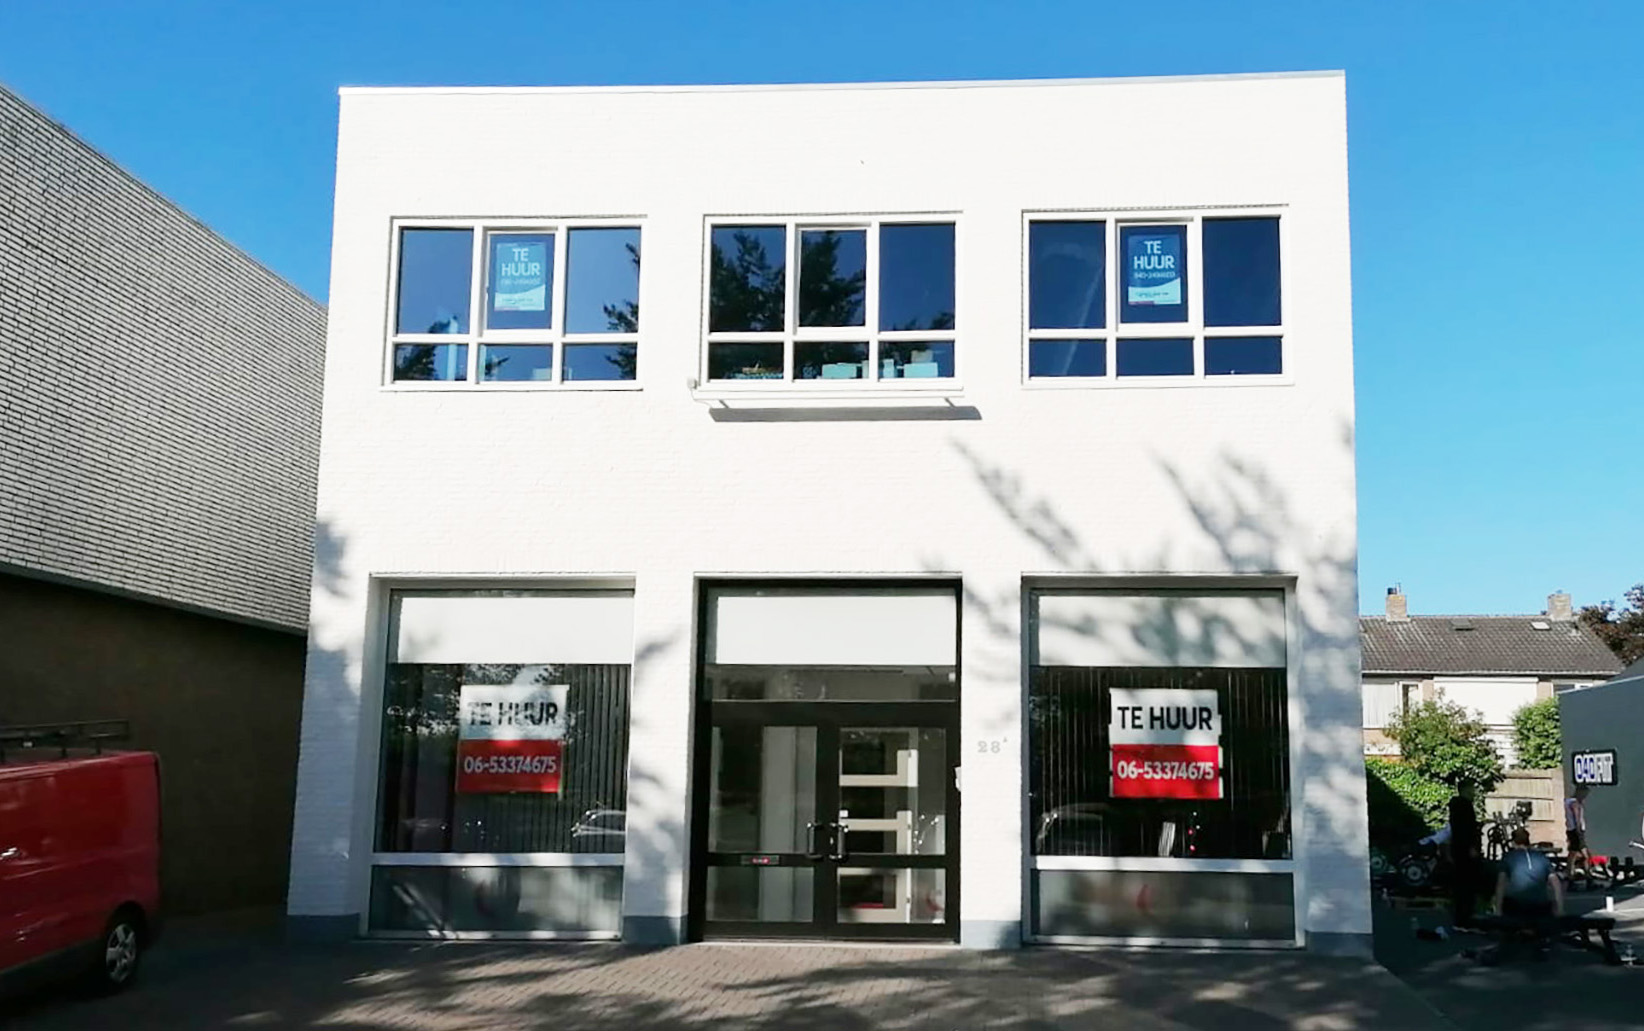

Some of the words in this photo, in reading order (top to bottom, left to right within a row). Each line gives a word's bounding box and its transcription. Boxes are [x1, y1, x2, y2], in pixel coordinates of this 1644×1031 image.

[512, 247, 529, 262] TE
[1144, 240, 1162, 254] TE
[501, 262, 541, 276] HUUR
[1133, 255, 1175, 269] HUUR
[468, 702, 492, 725] TE
[498, 702, 558, 725] HUUR
[1117, 706, 1144, 730] TE
[1149, 706, 1213, 731] HUUR
[464, 756, 557, 774] 06-53374675
[1117, 761, 1215, 780] 06-53374675
